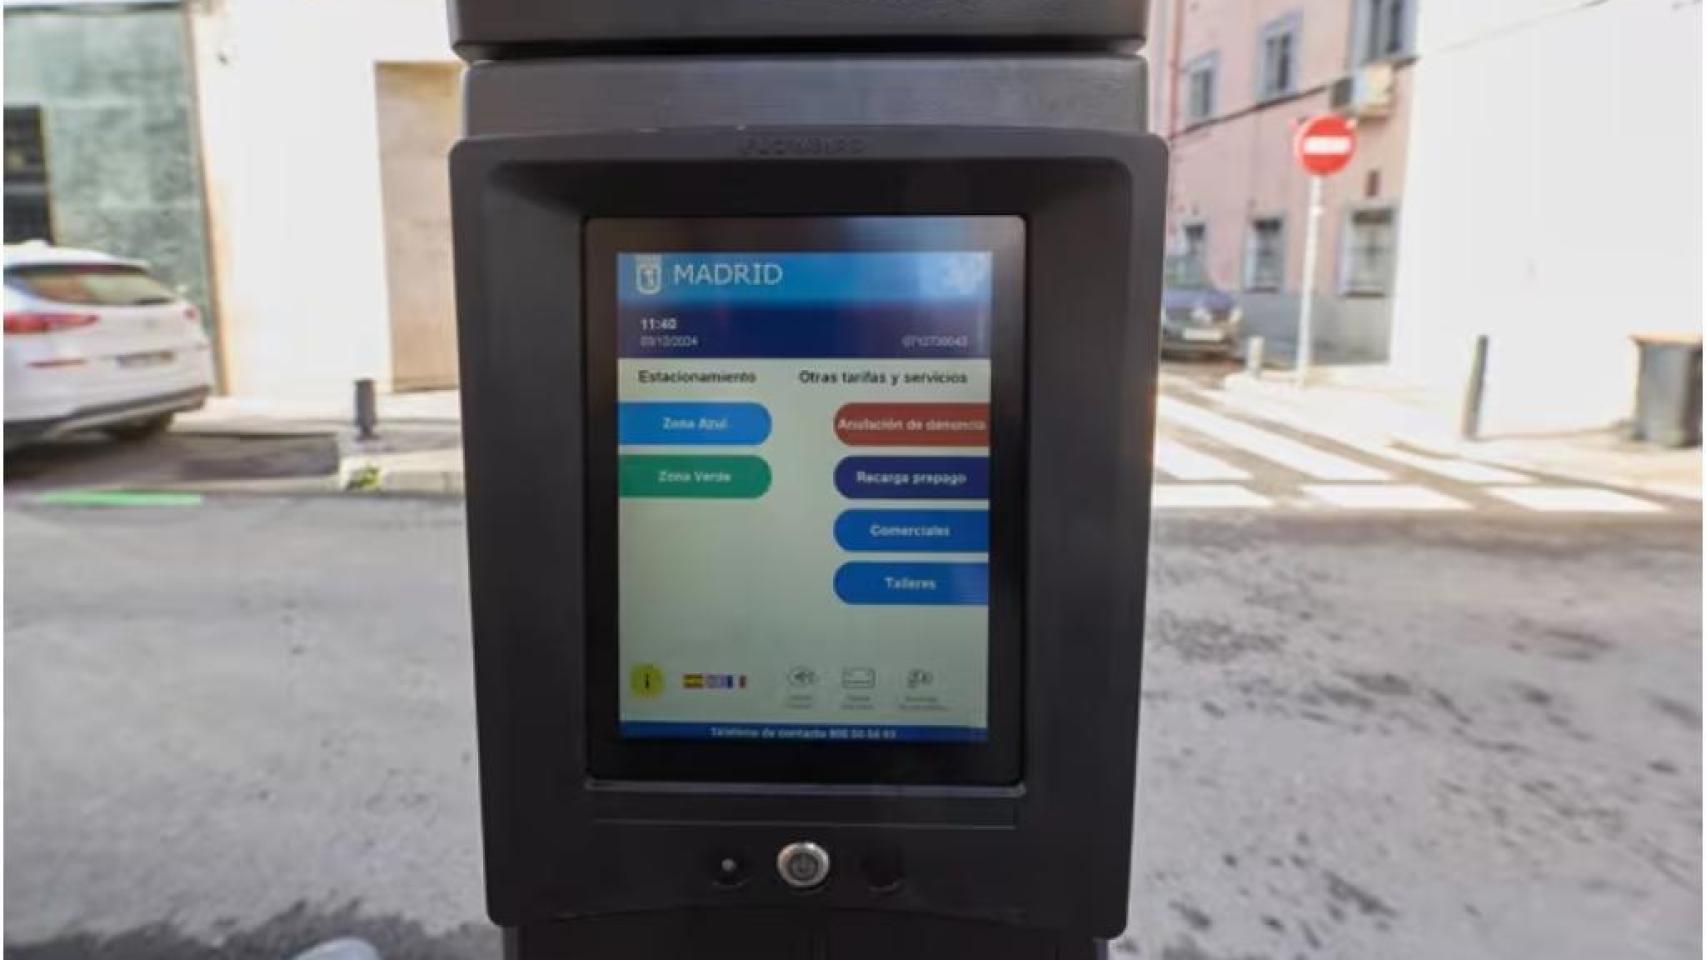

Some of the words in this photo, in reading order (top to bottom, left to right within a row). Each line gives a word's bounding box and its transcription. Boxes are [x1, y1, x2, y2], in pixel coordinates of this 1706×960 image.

[673, 263, 783, 286] MADRID
[638, 370, 757, 383] Estacionamiento
[799, 370, 837, 384] Otras
[842, 370, 886, 384] tarifas
[891, 372, 899, 386] y
[903, 371, 968, 384] servicios
[662, 417, 695, 430] Zona
[698, 417, 728, 431] Azul
[906, 419, 922, 431] de
[658, 470, 692, 483] Zona
[695, 470, 732, 483] Verde
[856, 470, 909, 484] Recarga
[912, 472, 967, 486] prepago
[869, 523, 951, 537] Comerciales
[885, 576, 937, 590] Talleres
